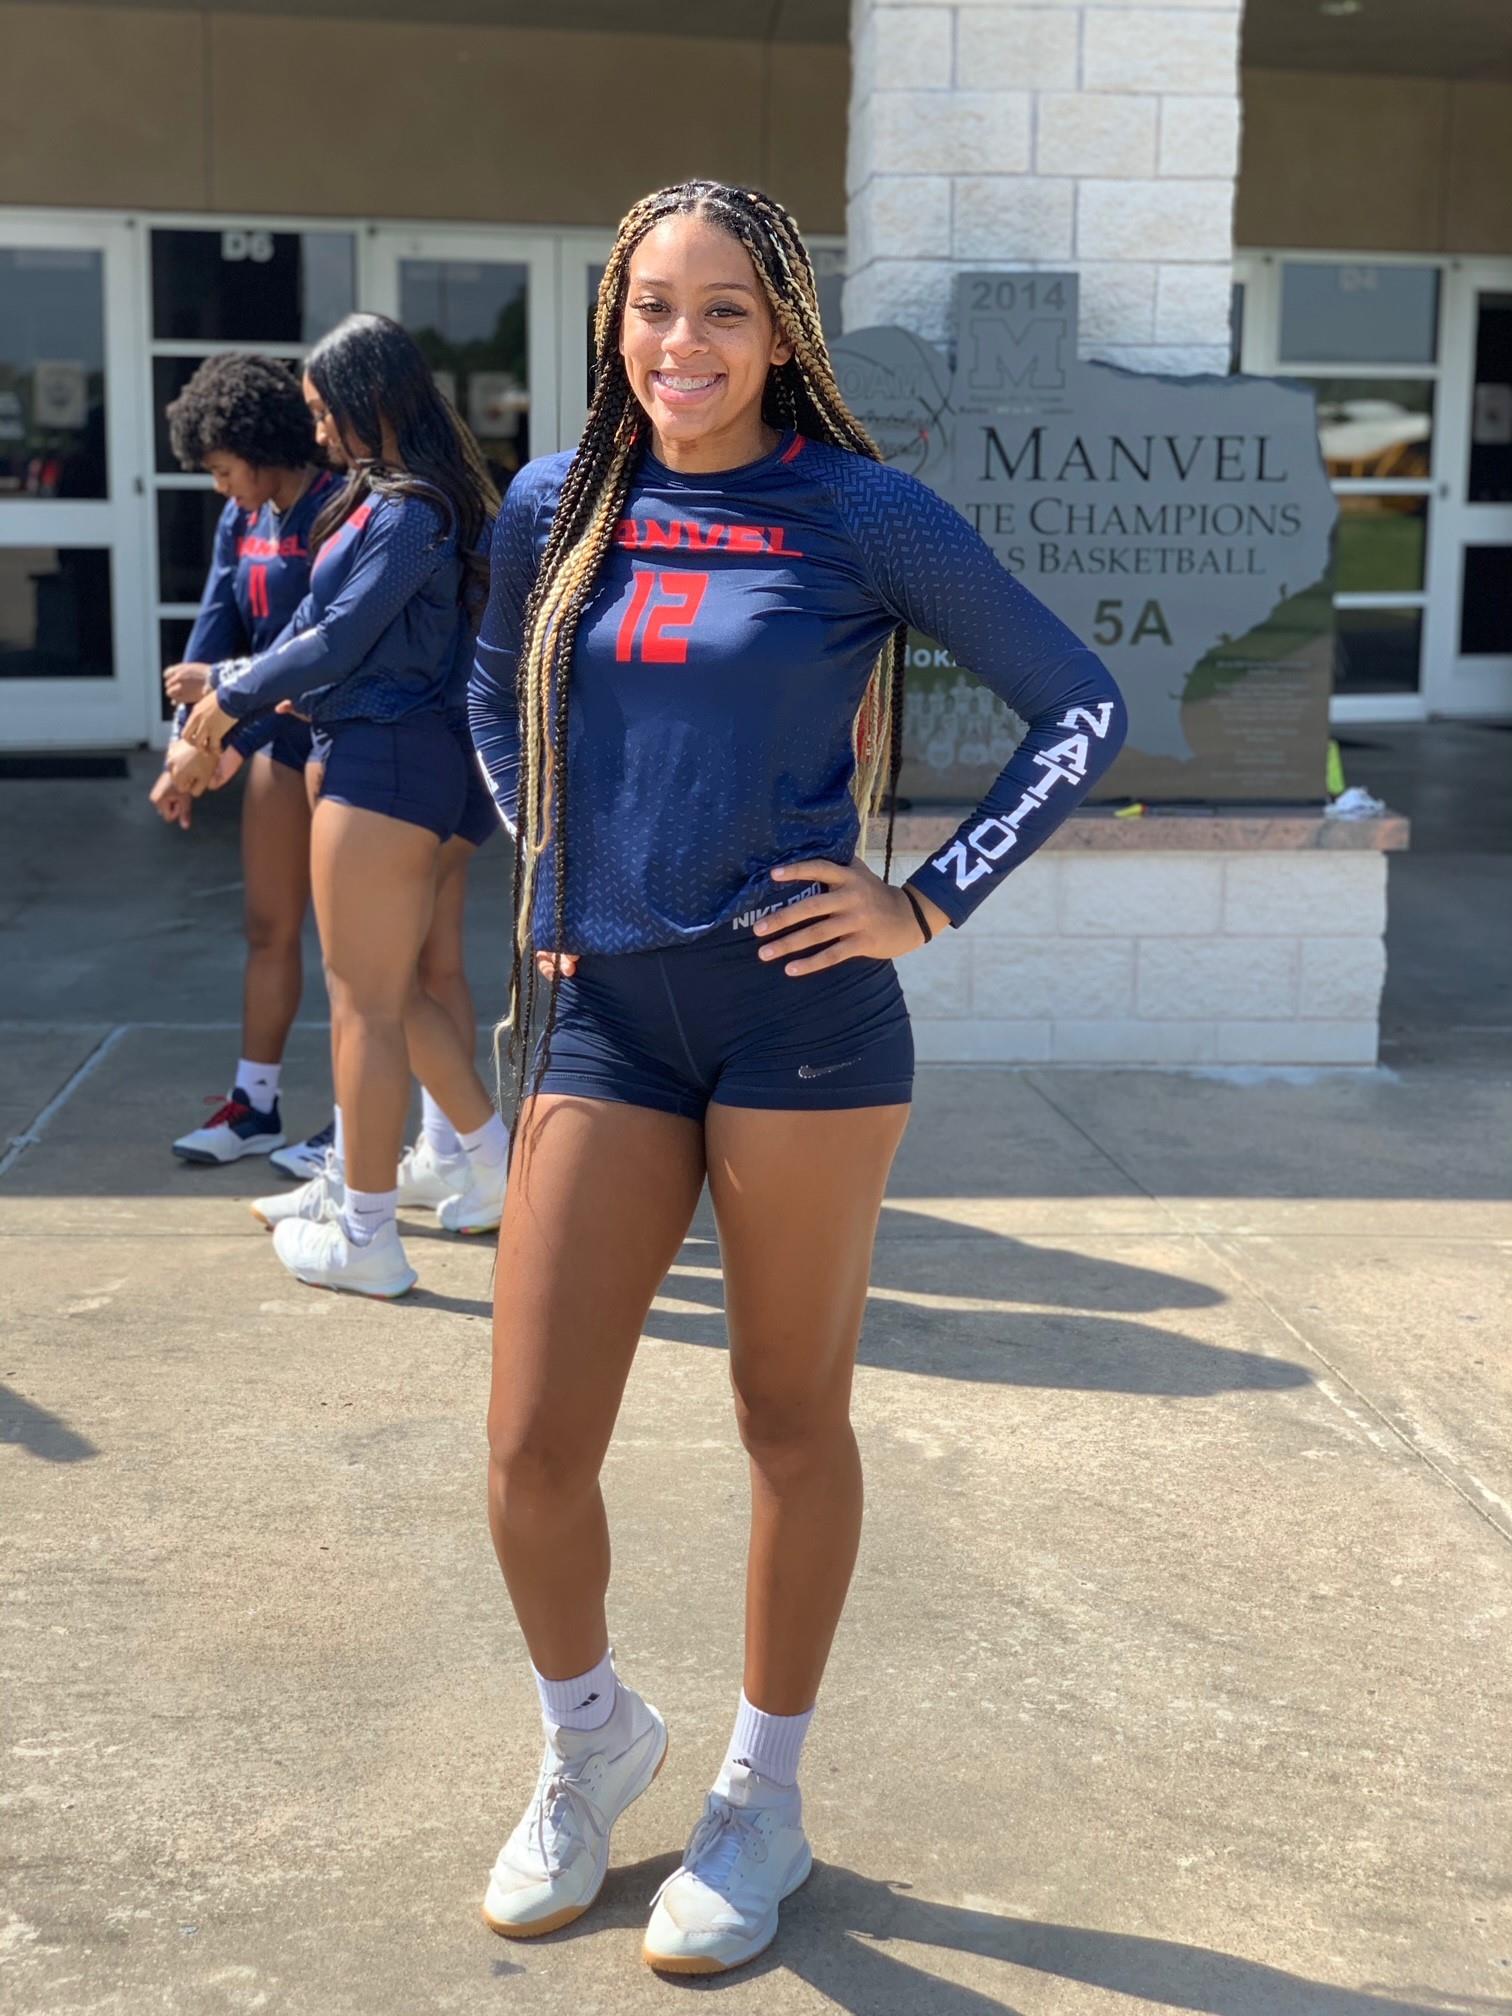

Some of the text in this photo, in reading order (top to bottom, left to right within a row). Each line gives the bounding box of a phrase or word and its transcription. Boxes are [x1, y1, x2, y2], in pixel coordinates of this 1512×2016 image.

[970, 279, 1066, 311] 2014
[968, 316, 1068, 390] M
[978, 425, 1289, 483] MANVEL
[613, 518, 803, 558] ANVEL
[1029, 496, 1302, 537] CHAMPIONS
[1038, 542, 1267, 575] BASKETBALL
[249, 564, 271, 618] 11
[615, 570, 709, 664] 12
[1093, 598, 1173, 647] 5A
[931, 701, 1114, 892] NATION
